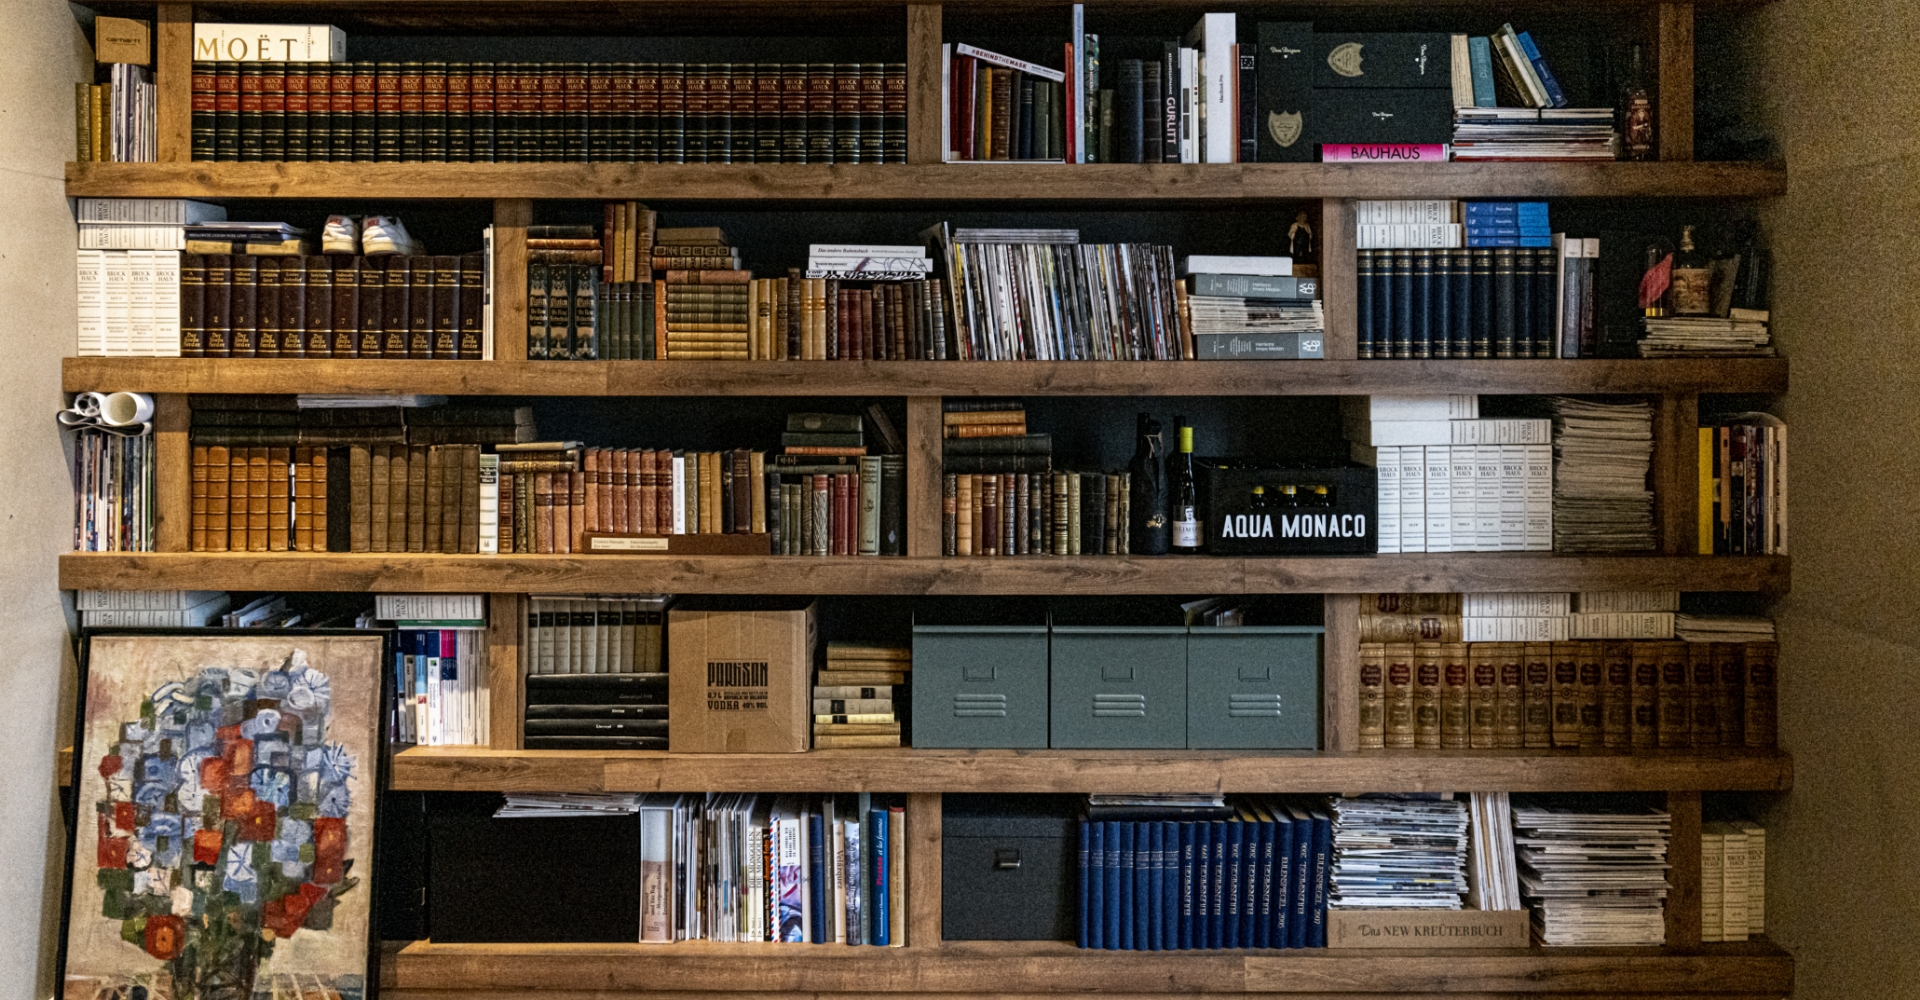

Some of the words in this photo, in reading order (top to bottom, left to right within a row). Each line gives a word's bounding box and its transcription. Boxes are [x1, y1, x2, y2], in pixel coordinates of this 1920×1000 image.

[197, 35, 297, 60] MOËT
[972, 49, 1028, 69] #BEHINDTHEMASK
[1166, 97, 1176, 144] GURLITT
[1351, 147, 1420, 159] BAUHAUS
[367, 219, 380, 227] NIKE
[1222, 514, 1274, 537] AQUA
[1282, 514, 1366, 537] MONACO
[708, 701, 739, 710] VODKA
[876, 818, 884, 840] femmes
[1300, 842, 1308, 858] 2006
[1184, 862, 1192, 916] EULENSPIEGEL
[1199, 862, 1207, 916] EULENSPIEGEL
[1213, 862, 1222, 916] EULENSPIEGEL
[1230, 861, 1238, 915] EULENSPIEGEL
[1246, 861, 1256, 915] EULENSPIEGEL
[1262, 861, 1271, 915] EULENSPIEGEL
[1279, 856, 1288, 909] EULENSPIEGEL
[1298, 861, 1306, 914] EULENSPIEGEL
[1315, 853, 1324, 905] EULENSPIEGEL
[1313, 909, 1321, 924] 2007
[1358, 925, 1380, 936] Das
[1383, 926, 1409, 936] NEW
[1414, 923, 1503, 936] KREÜTERBUCH
